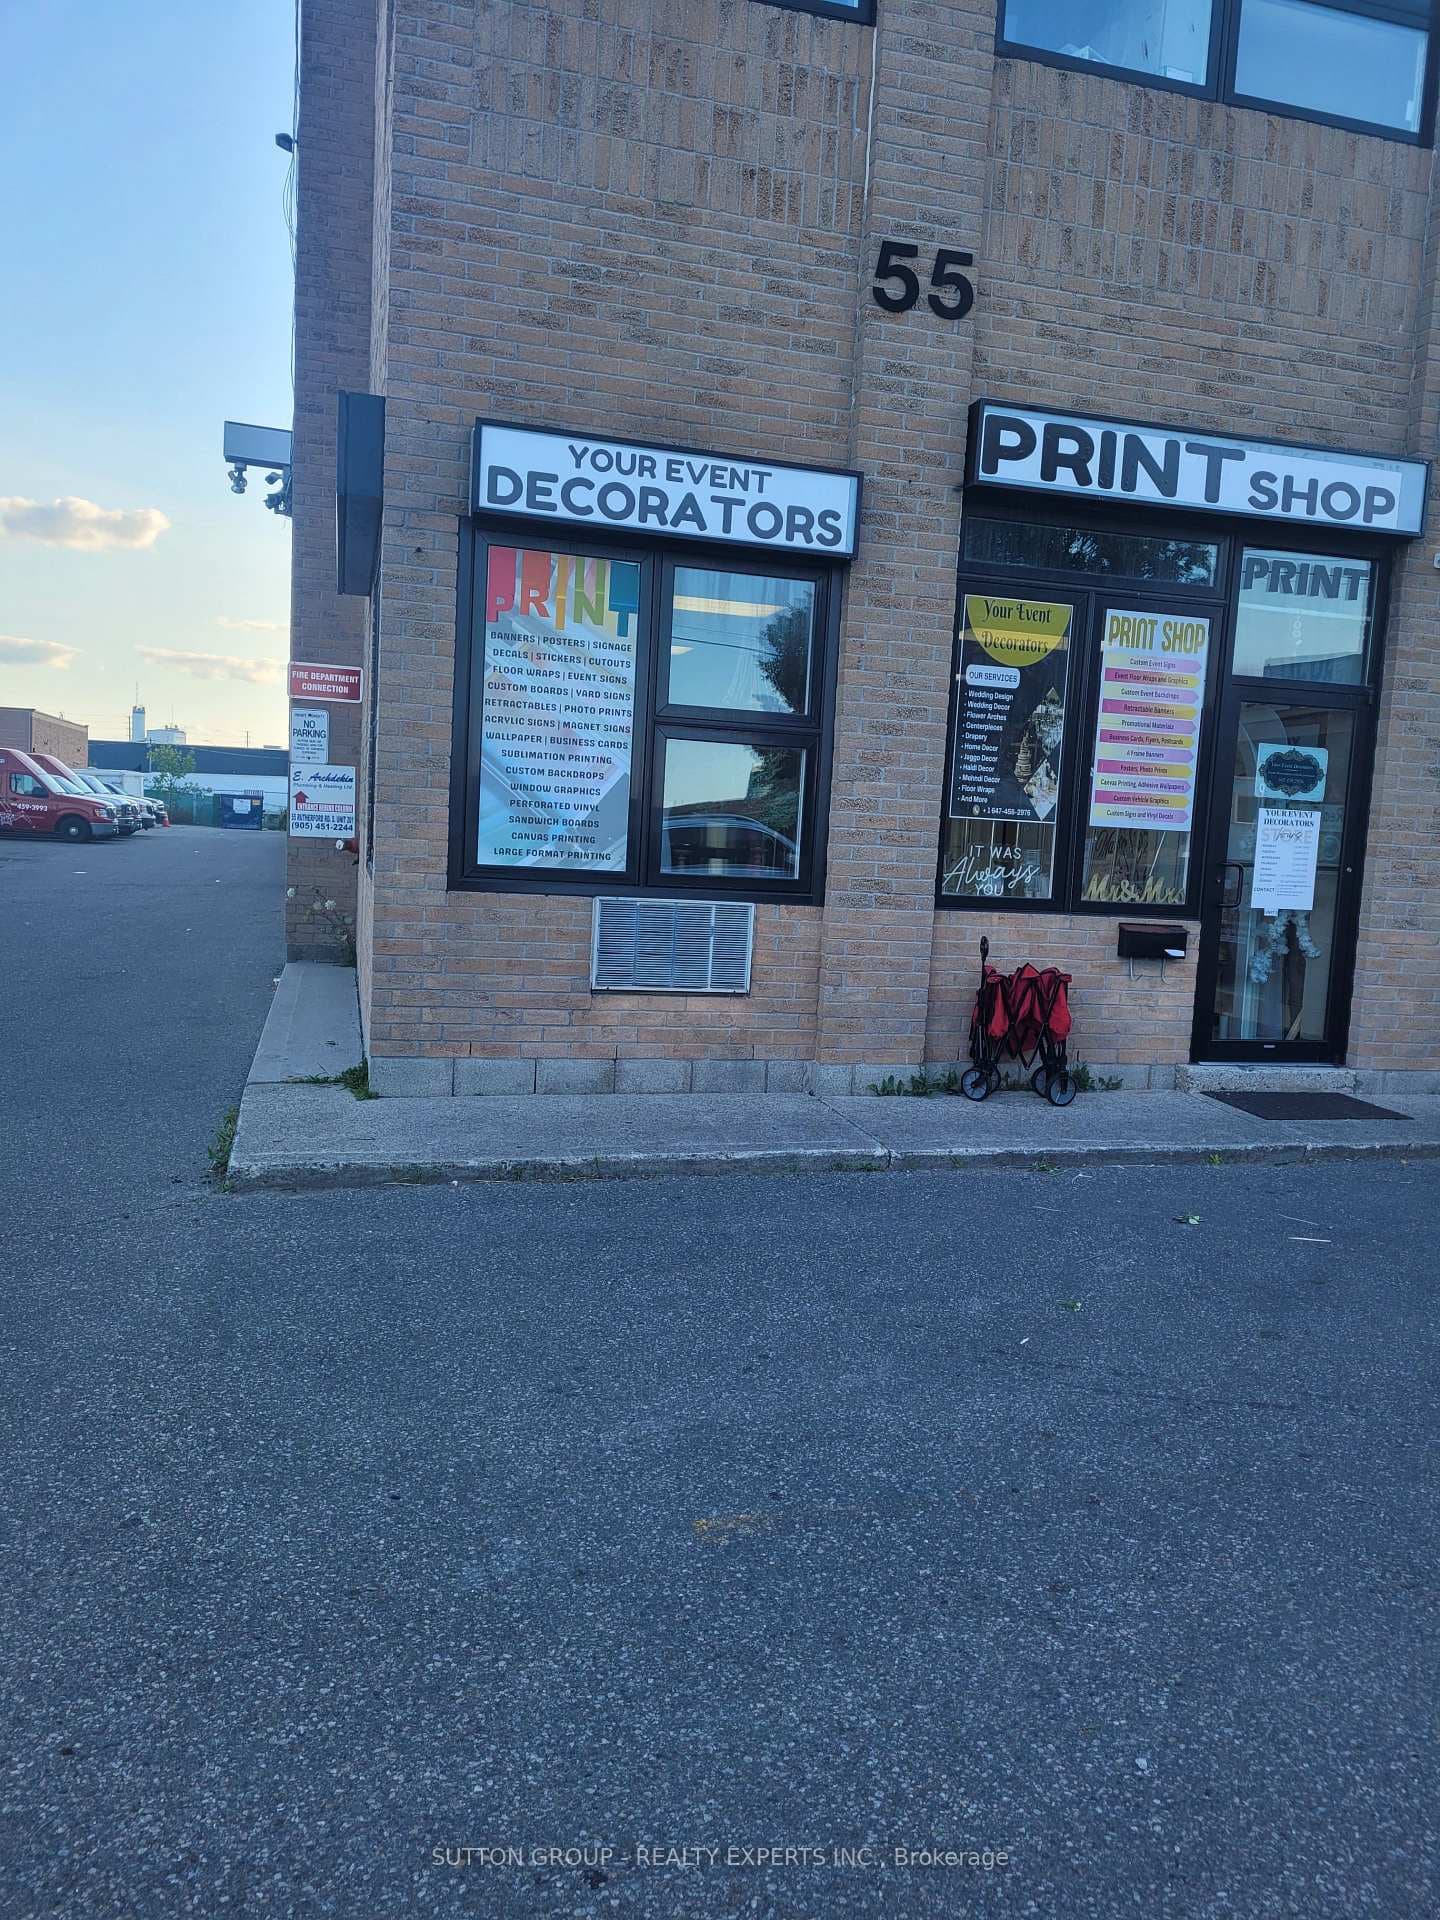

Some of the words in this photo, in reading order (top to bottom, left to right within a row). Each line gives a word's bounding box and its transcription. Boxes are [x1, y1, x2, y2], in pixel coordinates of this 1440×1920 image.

[873, 241, 973, 320] 55
[567, 445, 657, 480] YOUR
[666, 458, 773, 494] EVENT
[981, 413, 1246, 504] PRINT
[1247, 470, 1396, 524] SHOP
[486, 464, 842, 547] DECORATORS
[1241, 557, 1369, 601] PRINT
[487, 545, 639, 637] PRINT
[982, 600, 1013, 622] Your
[1016, 604, 1051, 624] Event
[491, 631, 535, 643] BANNERS
[543, 636, 585, 648] POSTERS
[593, 641, 632, 652] SIGNAGE
[1108, 615, 1158, 650] PRINT
[1161, 620, 1206, 654] SHOP
[981, 631, 1049, 653] Decorators
[493, 648, 528, 659] DECALS
[536, 652, 581, 664] STICKERS
[589, 657, 631, 668] CUTOUTS
[1129, 657, 1148, 667] Custom
[1148, 659, 1163, 668] Event
[292, 670, 309, 680] FIRE
[310, 672, 359, 684] DEPARTMENT
[493, 665, 524, 675] FLOOR
[526, 668, 560, 679] WRAPS
[568, 671, 598, 682] EVENT
[600, 674, 627, 685] SIGNS
[969, 671, 982, 680] OUR
[984, 672, 1018, 683] SERVICES
[301, 682, 349, 694] CONNECTION
[488, 681, 527, 693] CUSTOM
[530, 685, 569, 696] BOARDS
[576, 689, 600, 699] YARD
[603, 692, 631, 701] SIGNS
[1121, 687, 1140, 697] Custom
[968, 690, 994, 700] Wedding
[994, 692, 1014, 702] Design
[484, 698, 557, 712] RETRACTABLES
[564, 704, 596, 715] PHOTO
[598, 707, 632, 718] PRINTS
[967, 700, 993, 710] Wedding
[993, 702, 1011, 711] Decor
[966, 711, 986, 720] Flower
[303, 719, 316, 729] NO
[484, 715, 525, 726] ACRYLIC
[527, 718, 555, 728] SIGNS
[562, 721, 600, 732] MAGNET
[603, 724, 631, 734] SIGNS
[965, 722, 1003, 732] Centerpieces
[292, 728, 327, 739] PARKING
[485, 731, 542, 744] WALLPAPER
[550, 736, 595, 748] BUSINESS
[597, 740, 629, 750] CARDS
[965, 732, 988, 742] Drapery
[964, 743, 980, 751] Home
[981, 744, 999, 752] Decor
[501, 749, 566, 761] SUBLIMATION
[568, 753, 612, 765] PRINTING
[981, 754, 998, 762] Decor
[505, 766, 545, 776] CUSTOM
[548, 769, 605, 781] BACKDROPS
[977, 765, 995, 773] Decor
[510, 783, 552, 793] WINDOW
[554, 785, 601, 796] GRAPHICS
[509, 799, 571, 811] PERFORATED
[573, 802, 600, 813] VINYL
[1265, 809, 1287, 817] YOUR
[1288, 810, 1313, 819] EVENT
[291, 821, 313, 831] (905)
[508, 815, 559, 827] SANDWICH
[562, 818, 600, 828] BOARDS
[1263, 818, 1314, 827] DECORATORS
[511, 831, 549, 842] CANVAS
[551, 834, 596, 844] PRINTING
[493, 847, 523, 857] LARGE
[526, 849, 565, 859] FORMAT
[567, 851, 612, 862] PRINTING
[969, 845, 984, 858] IT
[990, 846, 1021, 860] WAS
[942, 856, 1040, 892] Always
[975, 883, 1004, 896] YOU
